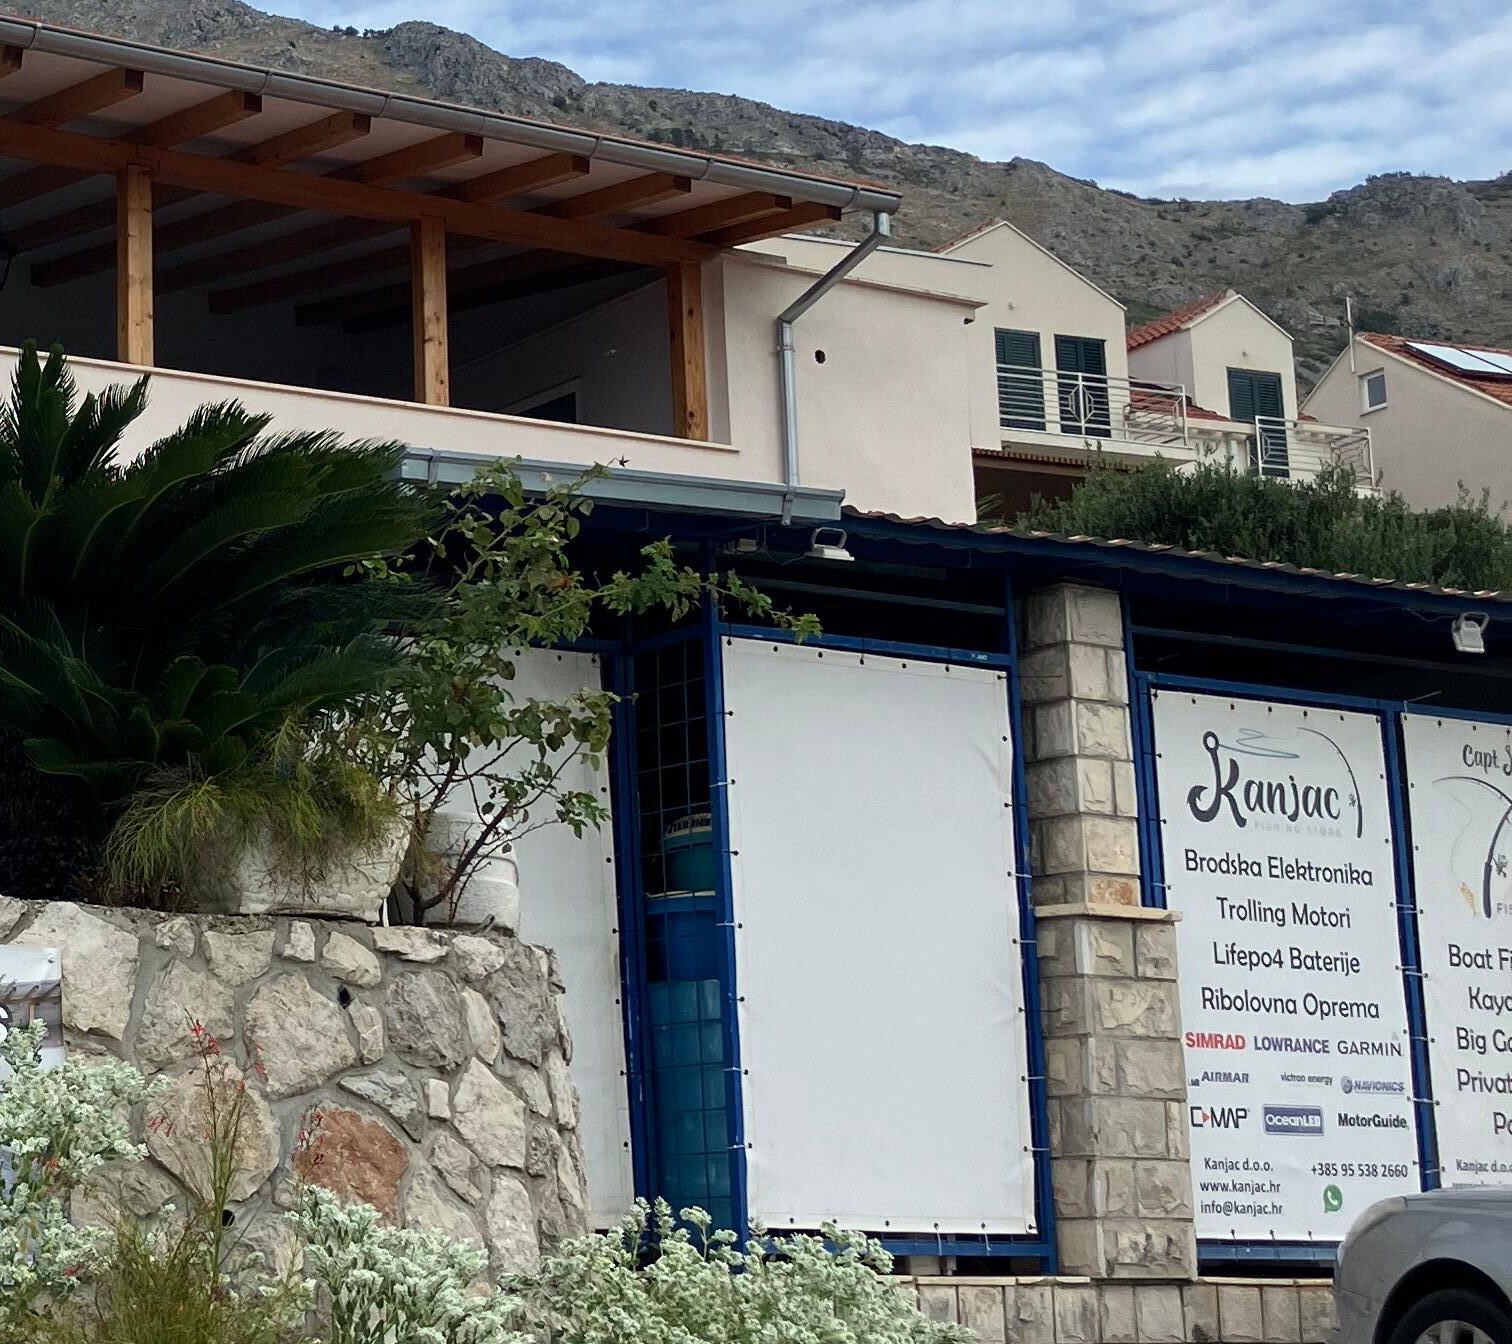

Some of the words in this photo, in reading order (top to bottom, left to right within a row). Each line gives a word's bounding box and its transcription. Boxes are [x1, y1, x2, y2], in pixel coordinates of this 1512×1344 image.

[1187, 731, 1341, 828] Kanjac
[1185, 848, 1262, 877] Brodska
[1267, 855, 1373, 886] Elektronika
[1216, 896, 1286, 927] Trolling
[1291, 902, 1351, 928] Motori
[1213, 941, 1283, 971] Lifepo4
[1289, 946, 1360, 976] Baterije
[1448, 943, 1493, 970] Boat
[1201, 986, 1297, 1015] Ribolovna
[1302, 992, 1380, 1020] Oprema
[1186, 1031, 1246, 1050] SIMRAD
[1254, 1035, 1330, 1054] LOWRANCE
[1337, 1040, 1402, 1057] GARMIN
[1456, 1026, 1486, 1055] Big
[1201, 1071, 1249, 1083] AIRMAR
[1308, 1075, 1333, 1086] energy
[1354, 1080, 1405, 1092] NAVIONICS
[1338, 1112, 1407, 1129] MotorGuide
[1204, 1157, 1240, 1174] Kanjac
[1242, 1158, 1274, 1171] d.o.o.
[1311, 1162, 1338, 1176] +385
[1341, 1163, 1355, 1176] 95
[1358, 1163, 1378, 1177] 538
[1381, 1164, 1408, 1178] 2660
[1456, 1158, 1488, 1174] Kanjac
[1199, 1180, 1281, 1195] www.kanjac.hr
[1200, 1200, 1283, 1217] info@kanjac.hr
